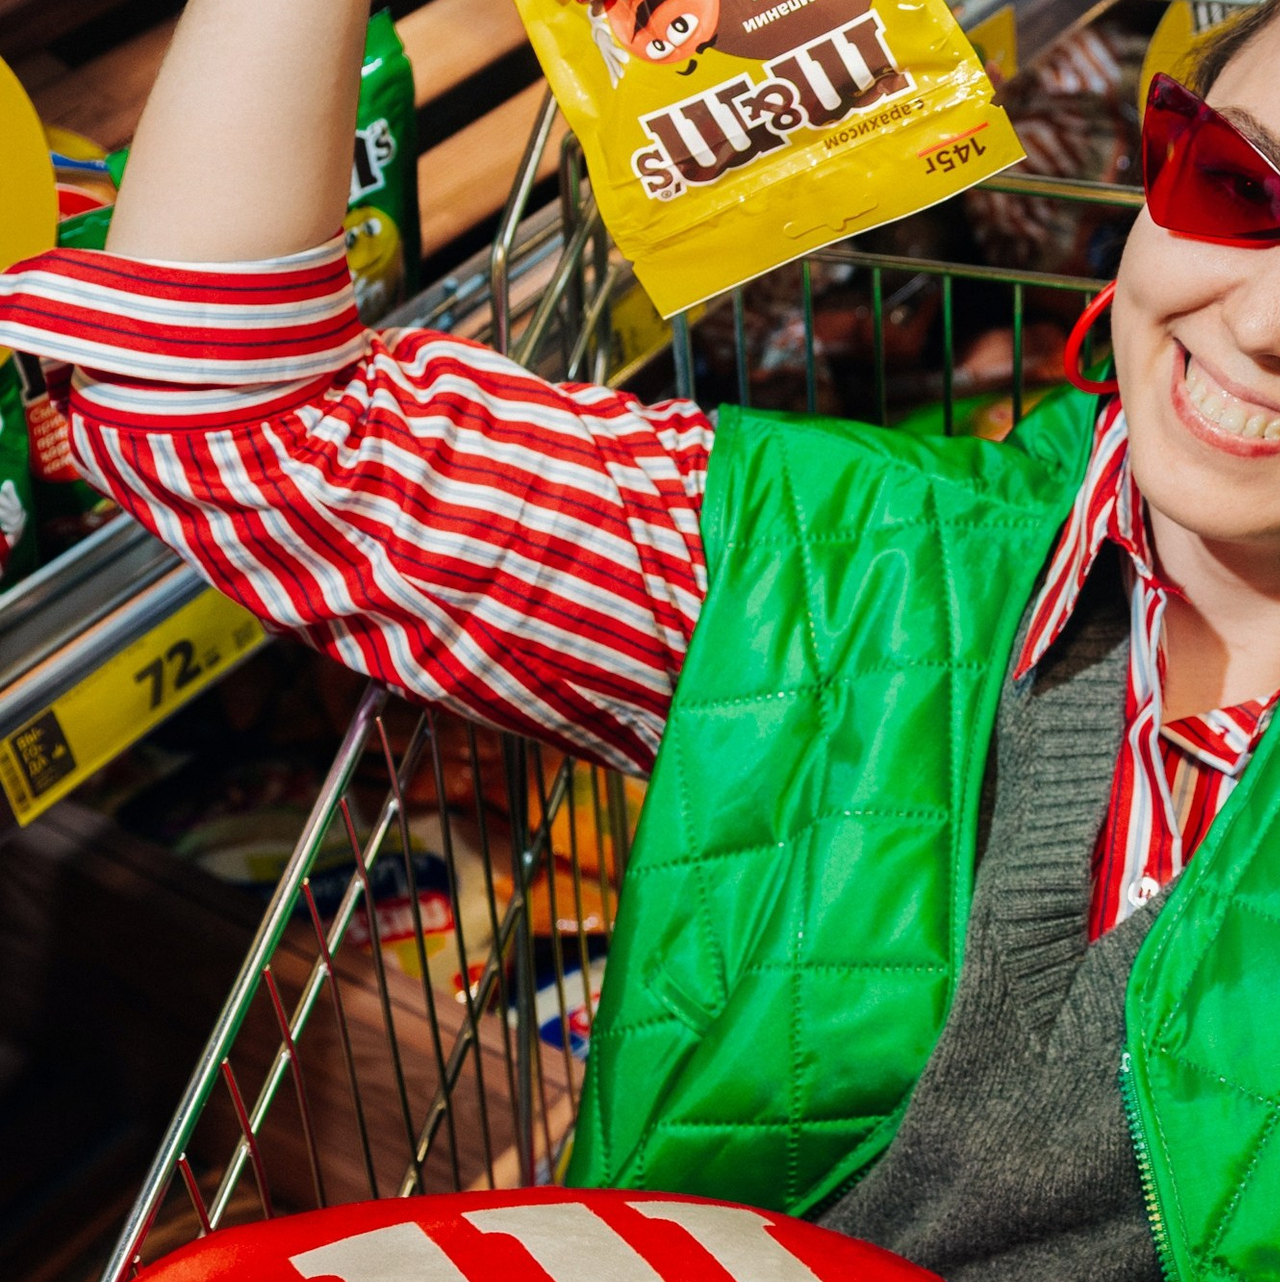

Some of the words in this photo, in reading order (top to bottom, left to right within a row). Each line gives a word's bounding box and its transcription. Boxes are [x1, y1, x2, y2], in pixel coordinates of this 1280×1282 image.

[823, 103, 914, 150] арахисом
[924, 136, 987, 176] 145г
[133, 638, 204, 712] 72
